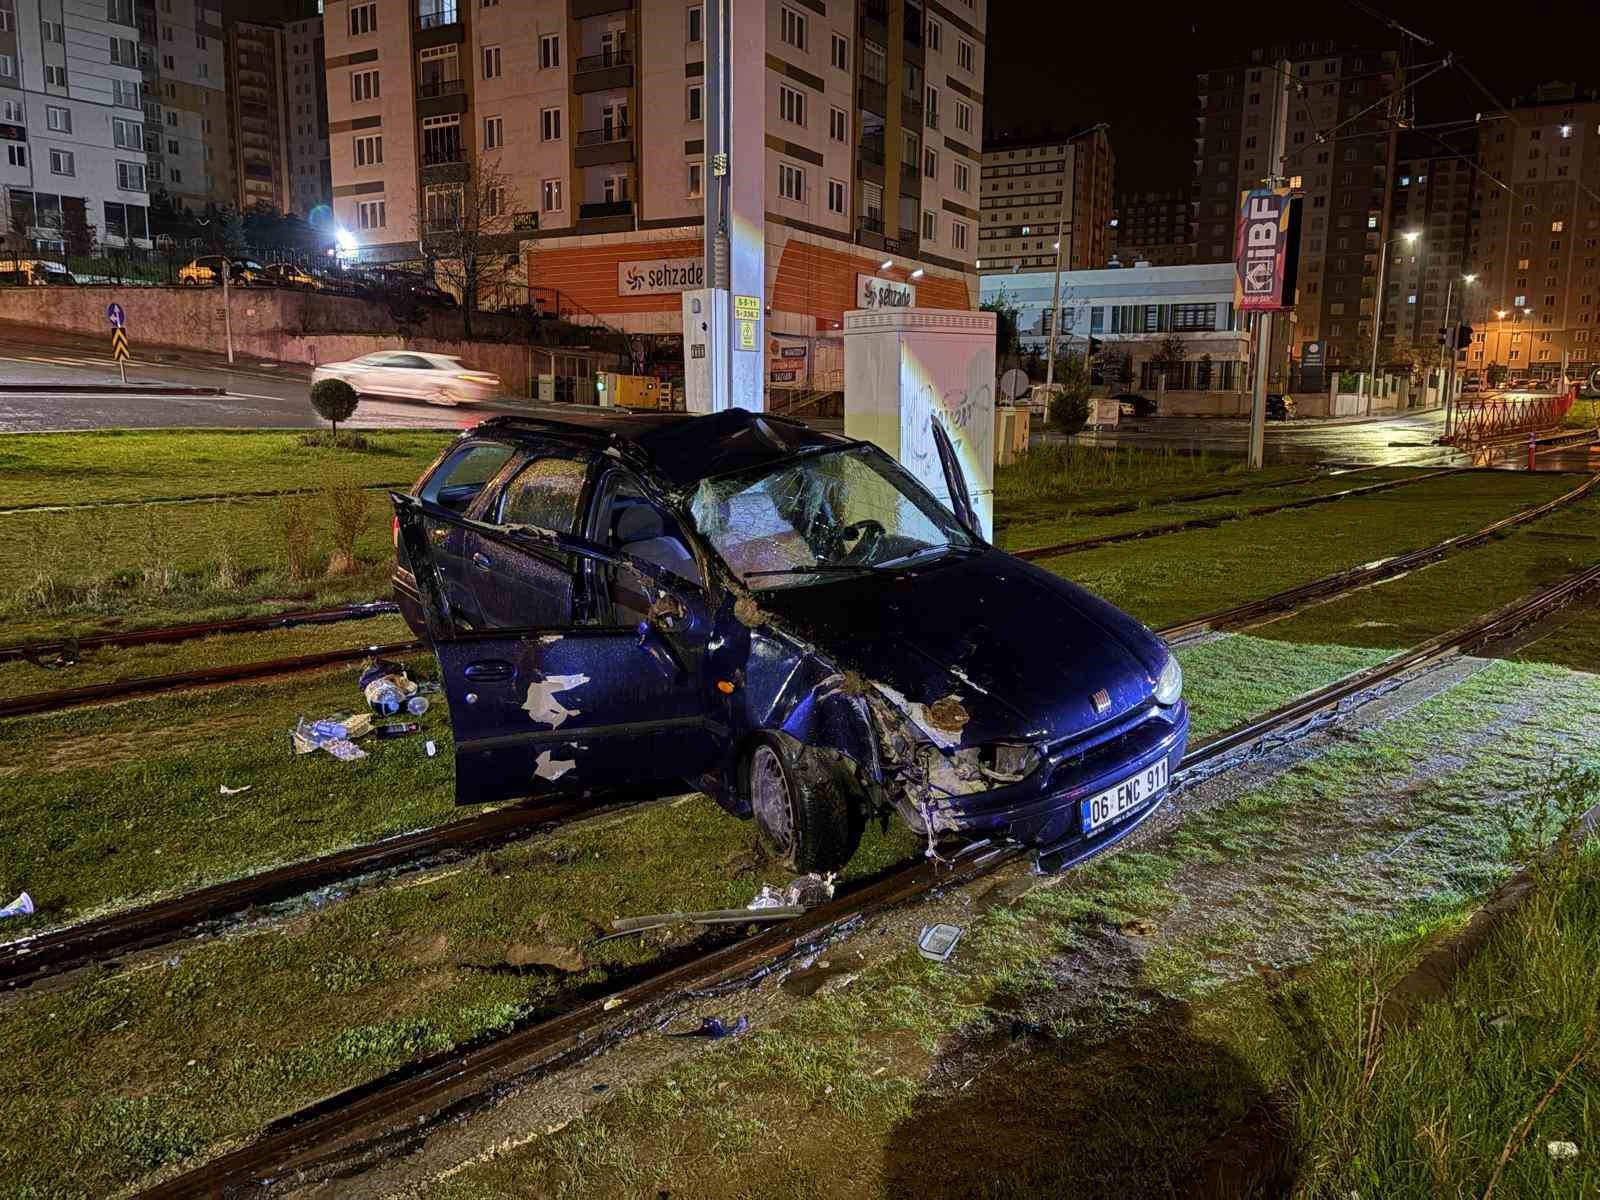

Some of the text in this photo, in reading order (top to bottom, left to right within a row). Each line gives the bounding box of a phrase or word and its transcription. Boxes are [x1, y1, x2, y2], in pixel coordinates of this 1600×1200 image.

[1092, 797, 1109, 823] 06
[1117, 778, 1141, 811] ENC
[1147, 761, 1167, 793] 911
